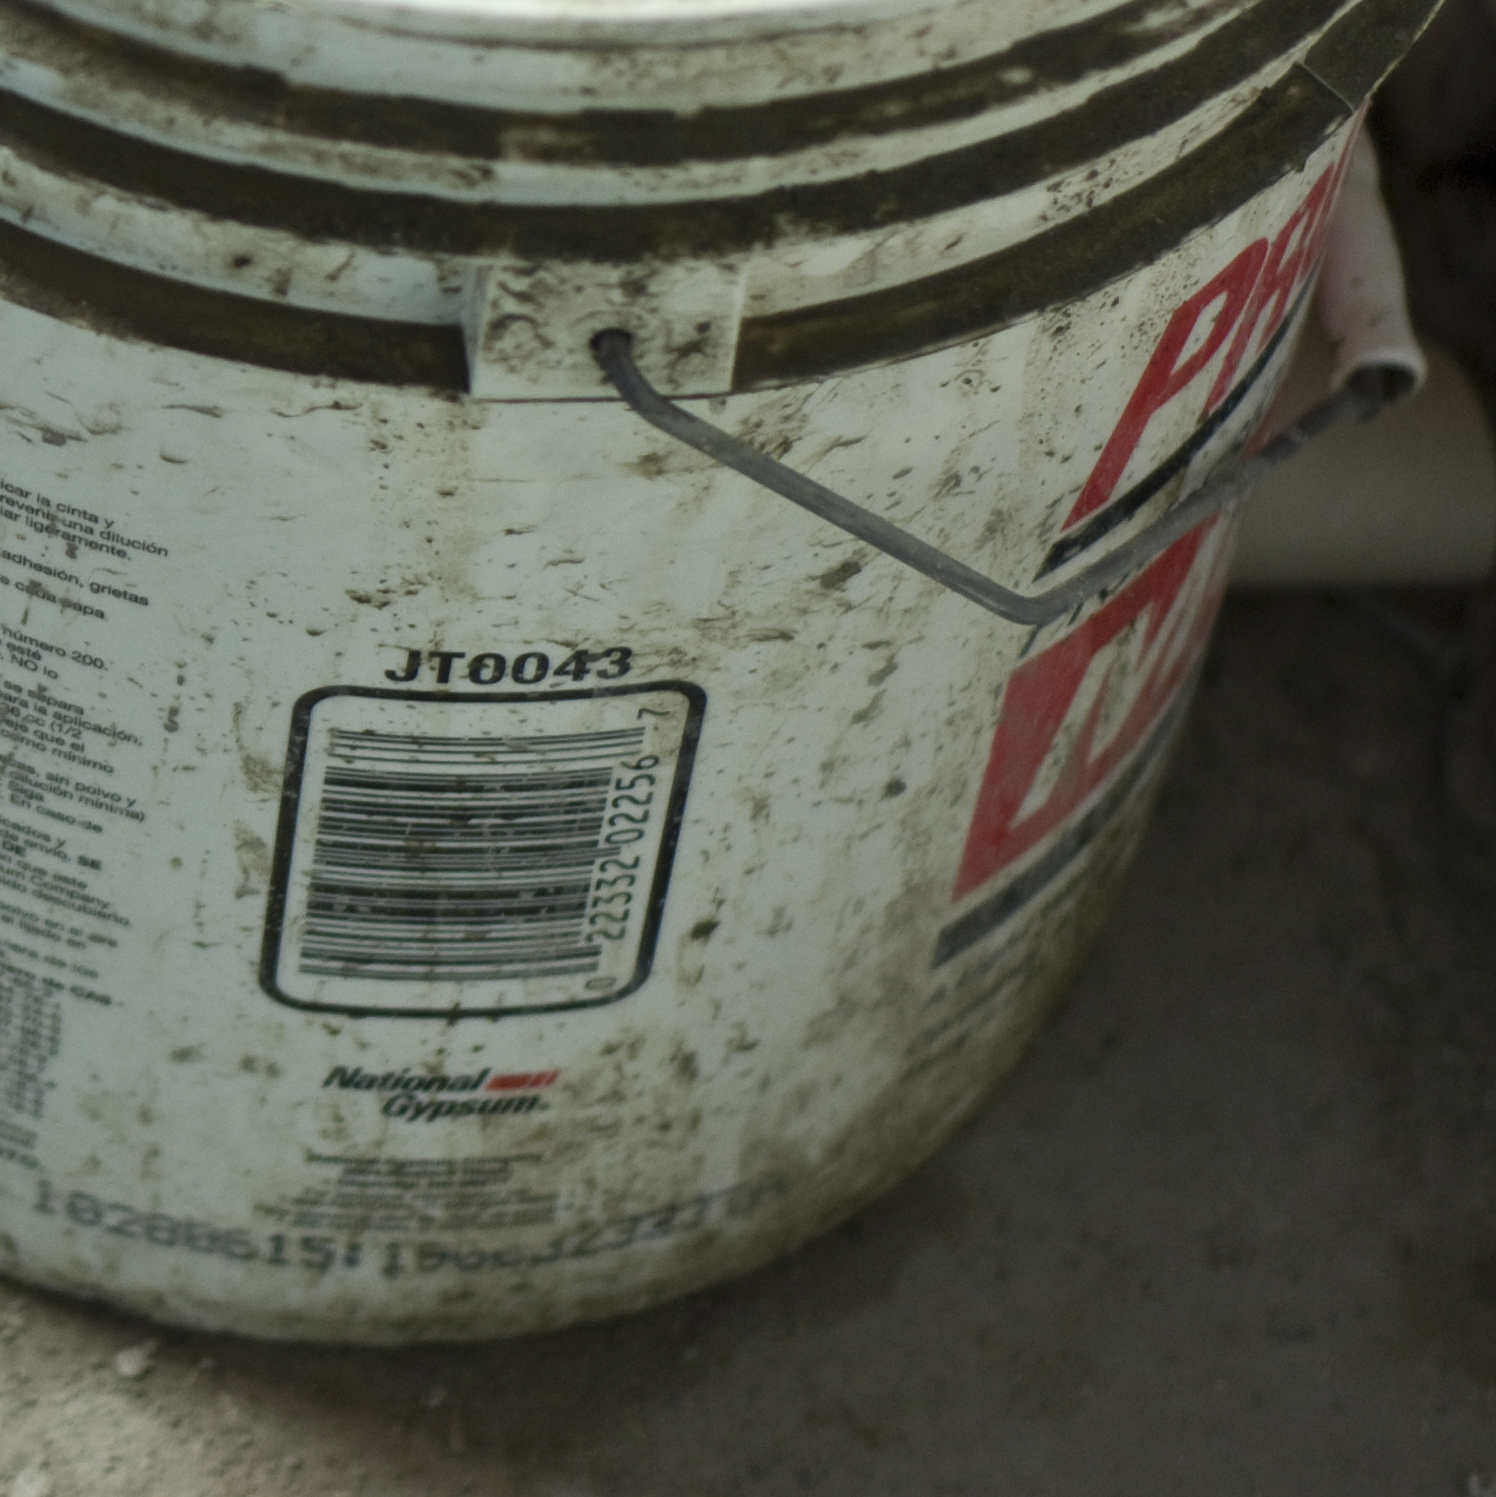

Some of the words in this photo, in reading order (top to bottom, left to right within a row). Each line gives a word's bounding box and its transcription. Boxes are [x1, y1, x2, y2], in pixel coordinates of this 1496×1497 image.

[36, 491, 51, 508] la
[55, 501, 99, 525] cinta
[103, 516, 115, 530] y
[24, 516, 131, 561] ligeramente.
[99, 523, 168, 558] dilución
[1, 548, 83, 588] adhesión,
[89, 580, 149, 607] grietas
[60, 596, 105, 621] apa
[1, 622, 66, 658] número
[71, 649, 108, 672] 200.
[6, 641, 42, 662] esté
[10, 652, 38, 673] NO
[43, 664, 59, 681] lo
[384, 646, 633, 685] JT0043
[34, 704, 47, 716] la
[33, 728, 65, 747] que
[70, 740, 85, 753] el
[51, 746, 114, 775] mínimo
[45, 771, 70, 787] sin
[74, 780, 121, 809] polvo
[126, 795, 137, 809] y
[605, 752, 662, 847] 02256
[321, 1064, 492, 1092] National
